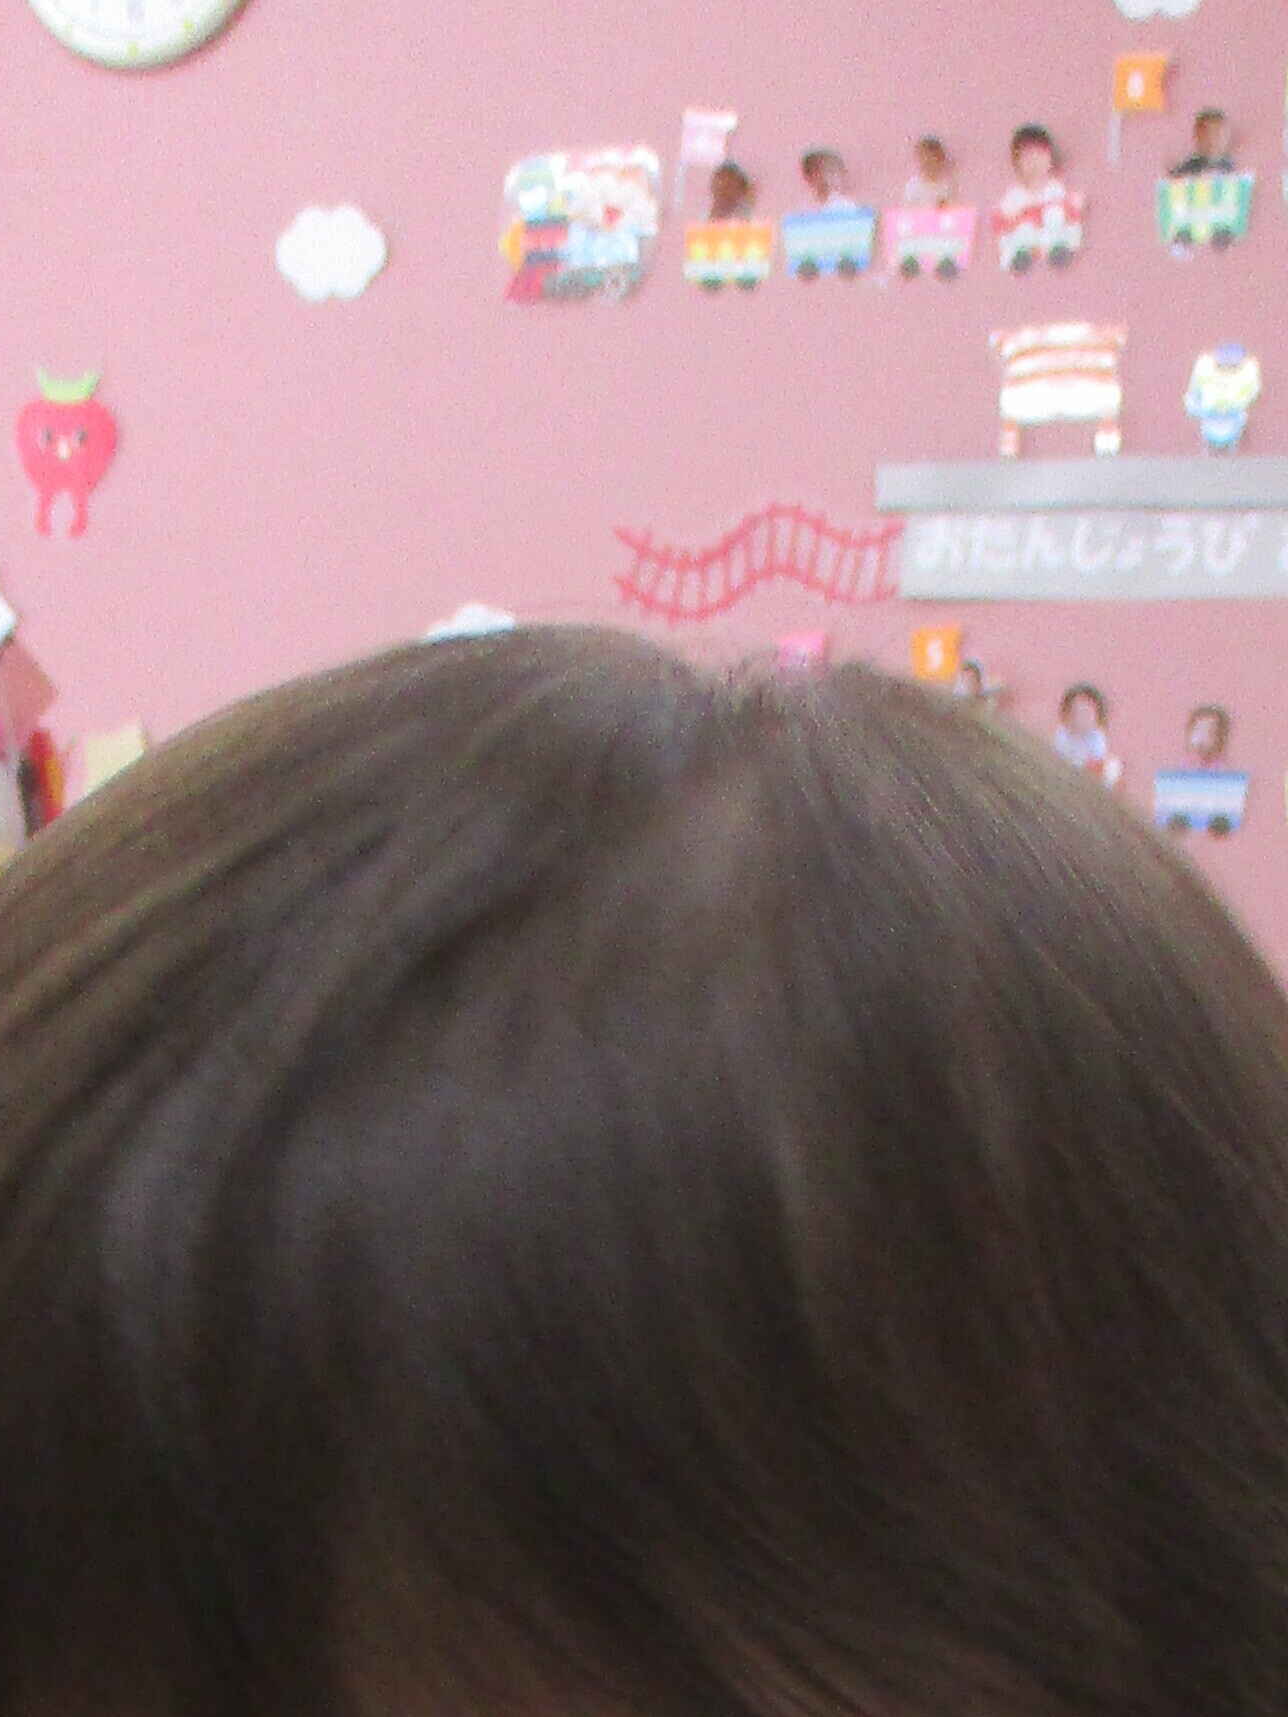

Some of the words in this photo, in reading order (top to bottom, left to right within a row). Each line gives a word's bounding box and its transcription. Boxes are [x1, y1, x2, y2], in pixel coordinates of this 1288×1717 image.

[917, 511, 1259, 572] おたんじょうび
